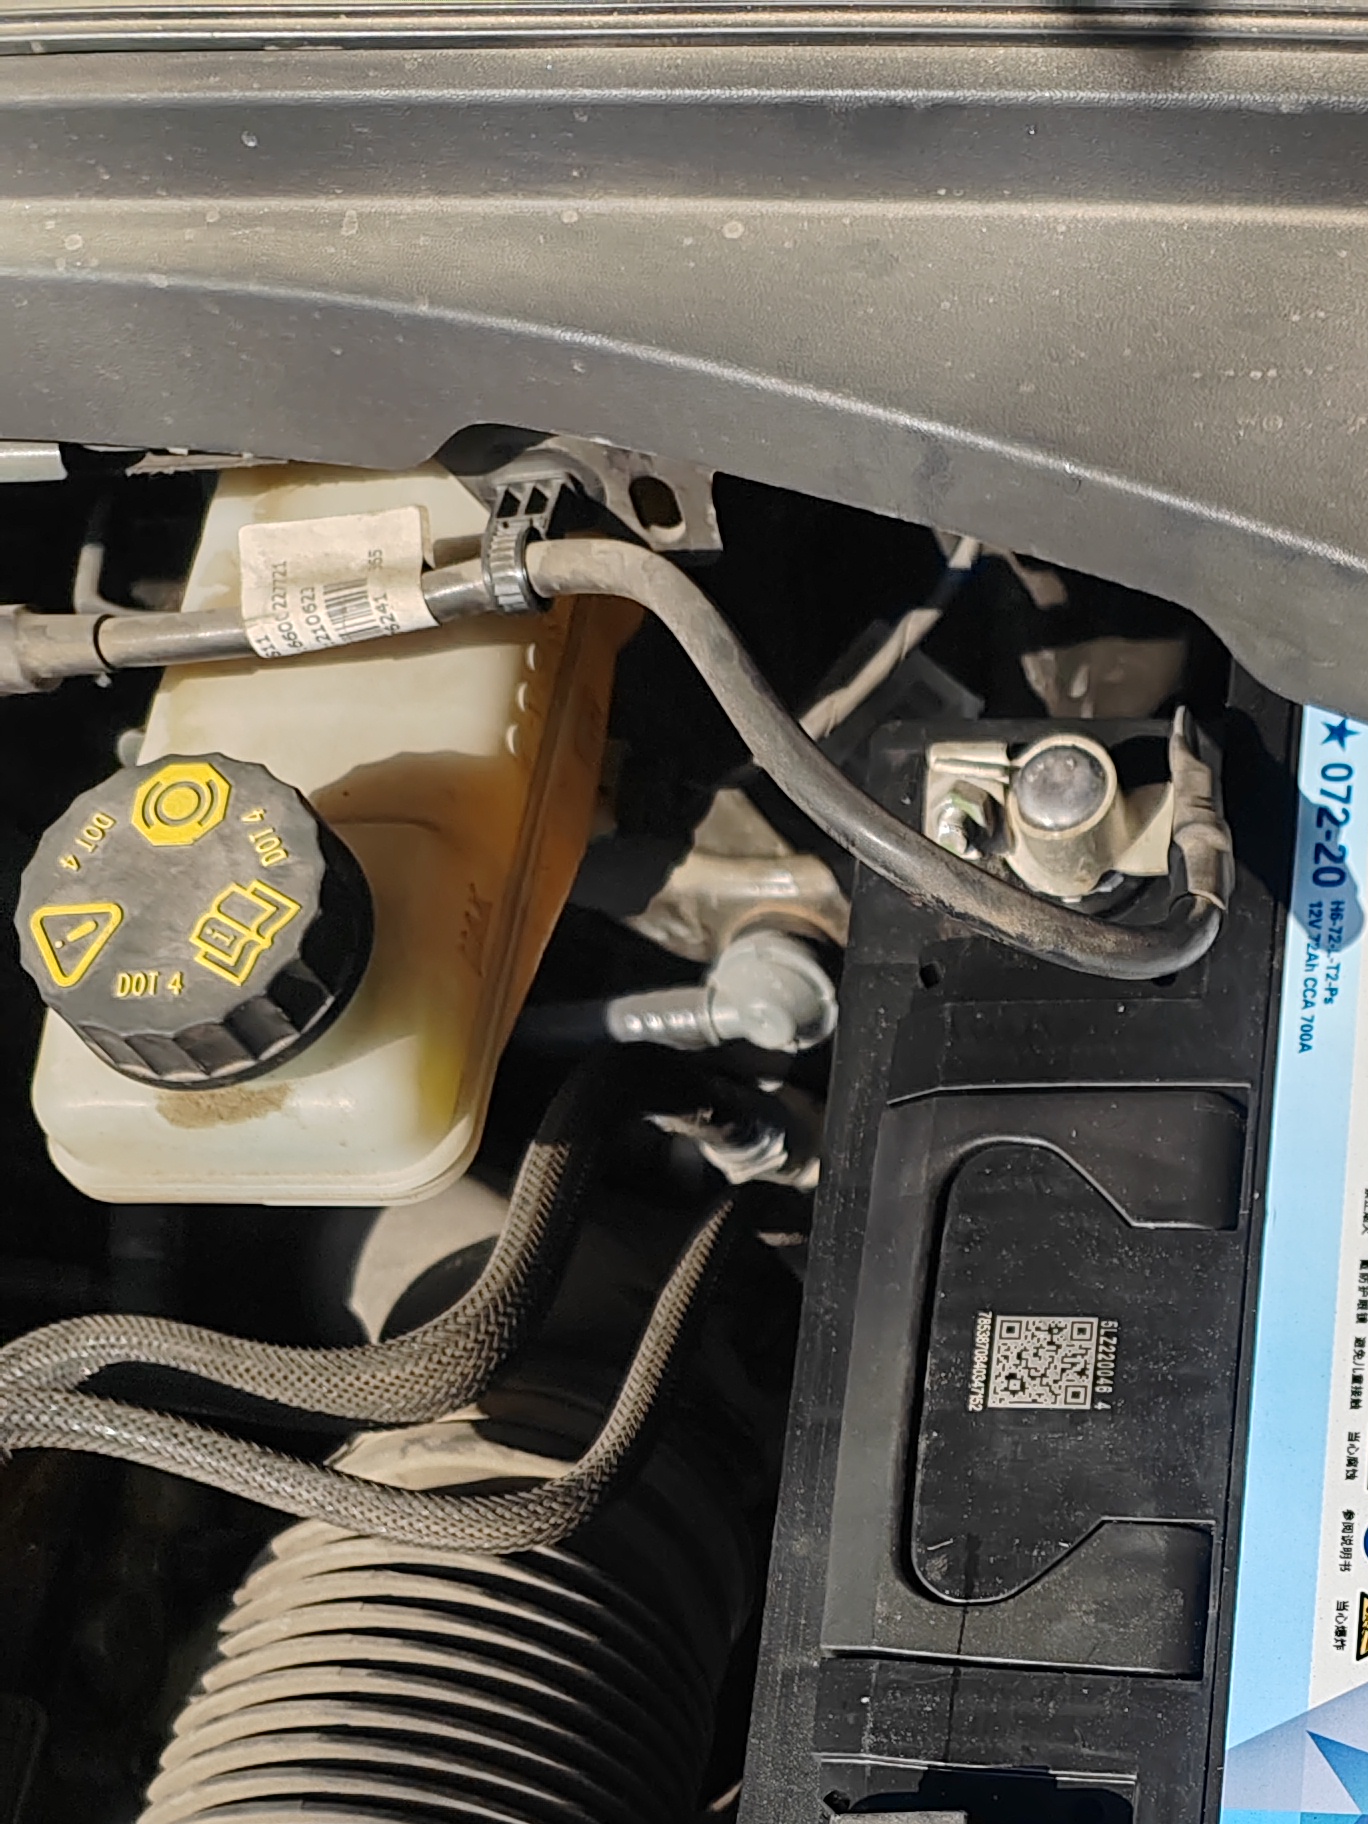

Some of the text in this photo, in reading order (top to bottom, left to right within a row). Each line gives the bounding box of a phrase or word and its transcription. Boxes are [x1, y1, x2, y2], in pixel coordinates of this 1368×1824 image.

[59, 813, 116, 871] DOT 4
[241, 808, 288, 867] DOT 4
[1311, 763, 1352, 887] 072-20
[117, 971, 184, 998] DOT 4
[1298, 901, 1322, 1053] 12V 72Ah CCA 700A
[1349, 1336, 1365, 1410] 避免儿童接触
[1344, 1431, 1358, 1480] 当心腐蚀
[1339, 1509, 1354, 1572] 参阅说明书
[1332, 1600, 1348, 1651] 当心爆炸
